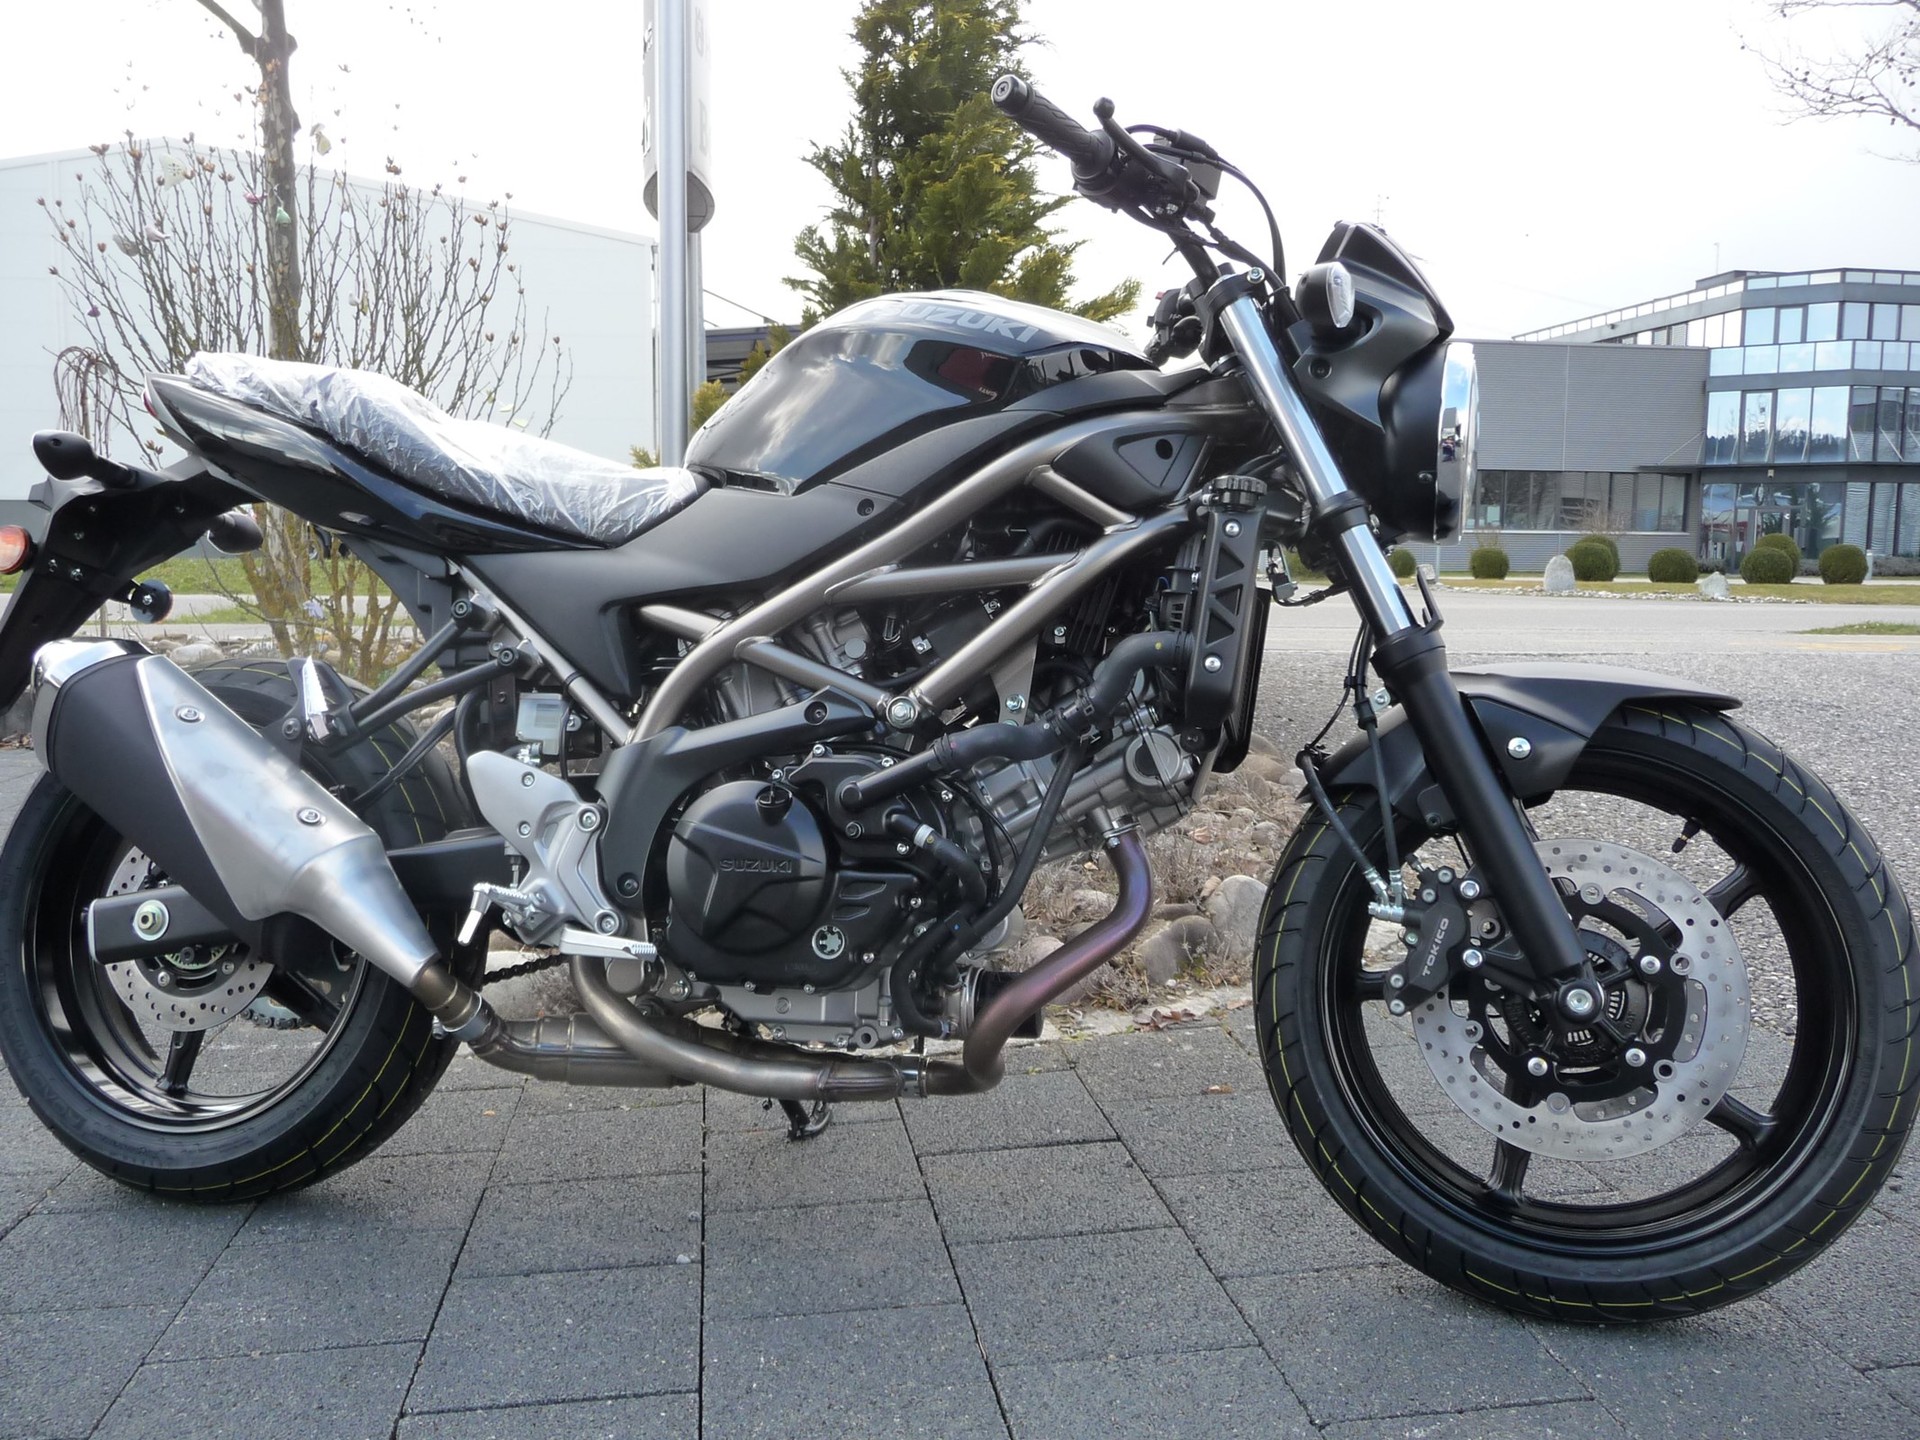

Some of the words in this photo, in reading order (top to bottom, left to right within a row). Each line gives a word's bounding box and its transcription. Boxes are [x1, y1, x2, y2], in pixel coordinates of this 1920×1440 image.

[872, 303, 1042, 343] SUZUKI
[719, 859, 792, 873] SUZUKI
[1421, 917, 1449, 977] TOKICO
